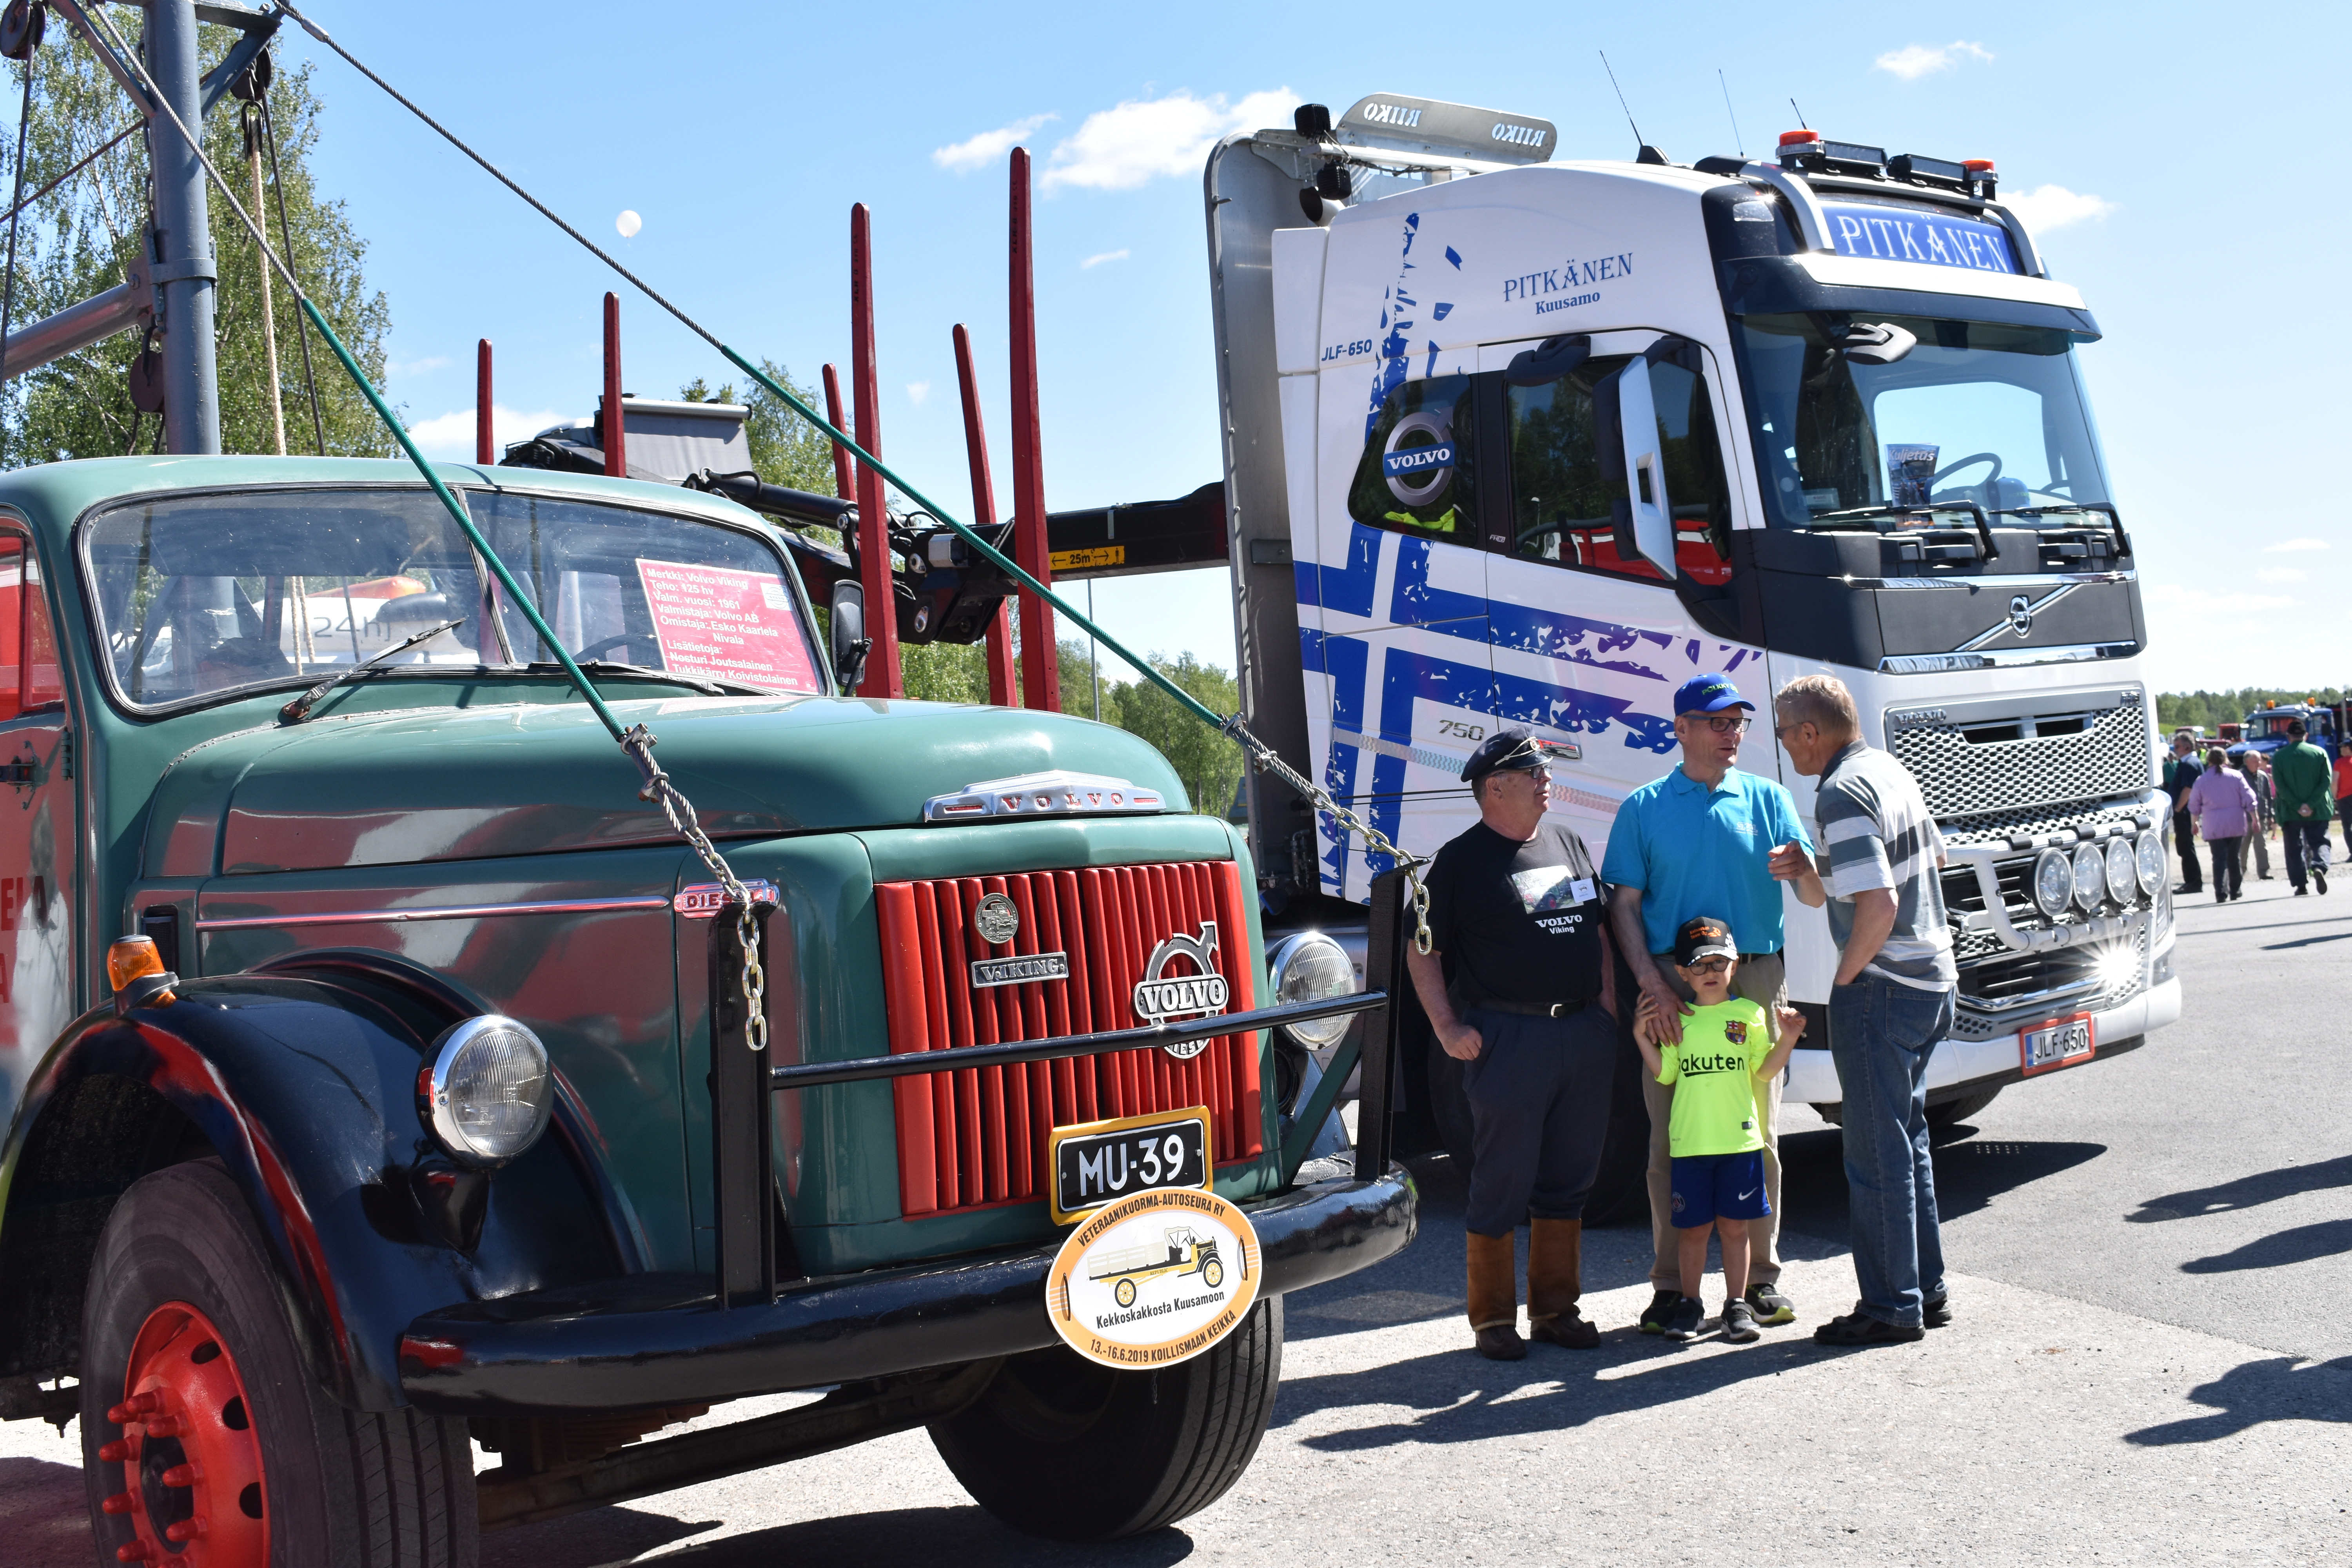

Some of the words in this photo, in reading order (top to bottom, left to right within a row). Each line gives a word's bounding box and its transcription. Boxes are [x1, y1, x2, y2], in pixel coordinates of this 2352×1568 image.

[1837, 214, 2009, 273] PITKÄNEN
[1503, 253, 1633, 303] PITKÄNEN
[1535, 292, 1601, 314] Kuusamo
[1321, 339, 1372, 361] JLF-650
[1387, 448, 1450, 470] VOLVO
[1889, 449, 1935, 463] Kuljetus
[1069, 554, 1091, 564] 25m
[646, 568, 684, 581] Merkki:
[686, 573, 715, 584] Volvo
[717, 576, 748, 589] Viking
[650, 580, 678, 592] Teho:
[681, 583, 699, 593] 125
[702, 586, 714, 595] hv
[653, 592, 682, 603] Valm.
[685, 596, 715, 607] vuosi:
[718, 599, 740, 610] 1961
[656, 604, 712, 619] Valmistaja:
[714, 610, 742, 622] Volvo
[745, 613, 759, 623] AB
[661, 616, 709, 630] Omistaja:
[711, 622, 736, 632] Esko
[739, 624, 779, 637] Kaarlela
[666, 640, 723, 655] Lisätietoja:
[713, 633, 744, 645] Nivala
[672, 664, 726, 679] Tukkikärry
[728, 670, 798, 685] Koivistolainen
[710, 658, 773, 671] Joutsalainen
[1439, 720, 1485, 741] 750
[1002, 793, 1123, 809] VOLVO
[1535, 915, 1583, 927] VOLVO
[981, 958, 1058, 981] VIKING
[1142, 979, 1225, 1013] VOLVO
[2036, 1027, 2085, 1058] JLF-650
[1679, 1054, 1744, 1073] akuten
[1079, 1134, 1185, 1196] MU-39
[1077, 1193, 1212, 1247] VETERAANIKUORMA-AUTOSEURA
[1214, 1204, 1226, 1217] RY
[1096, 1303, 1172, 1329] Kekkoskakkosta
[1174, 1291, 1225, 1311] Kuusamoon
[1091, 1339, 1149, 1363] 13.-16.6.2019
[1151, 1335, 1208, 1362] KOILLISMAAN
[1208, 1310, 1236, 1339] KEIKKA
